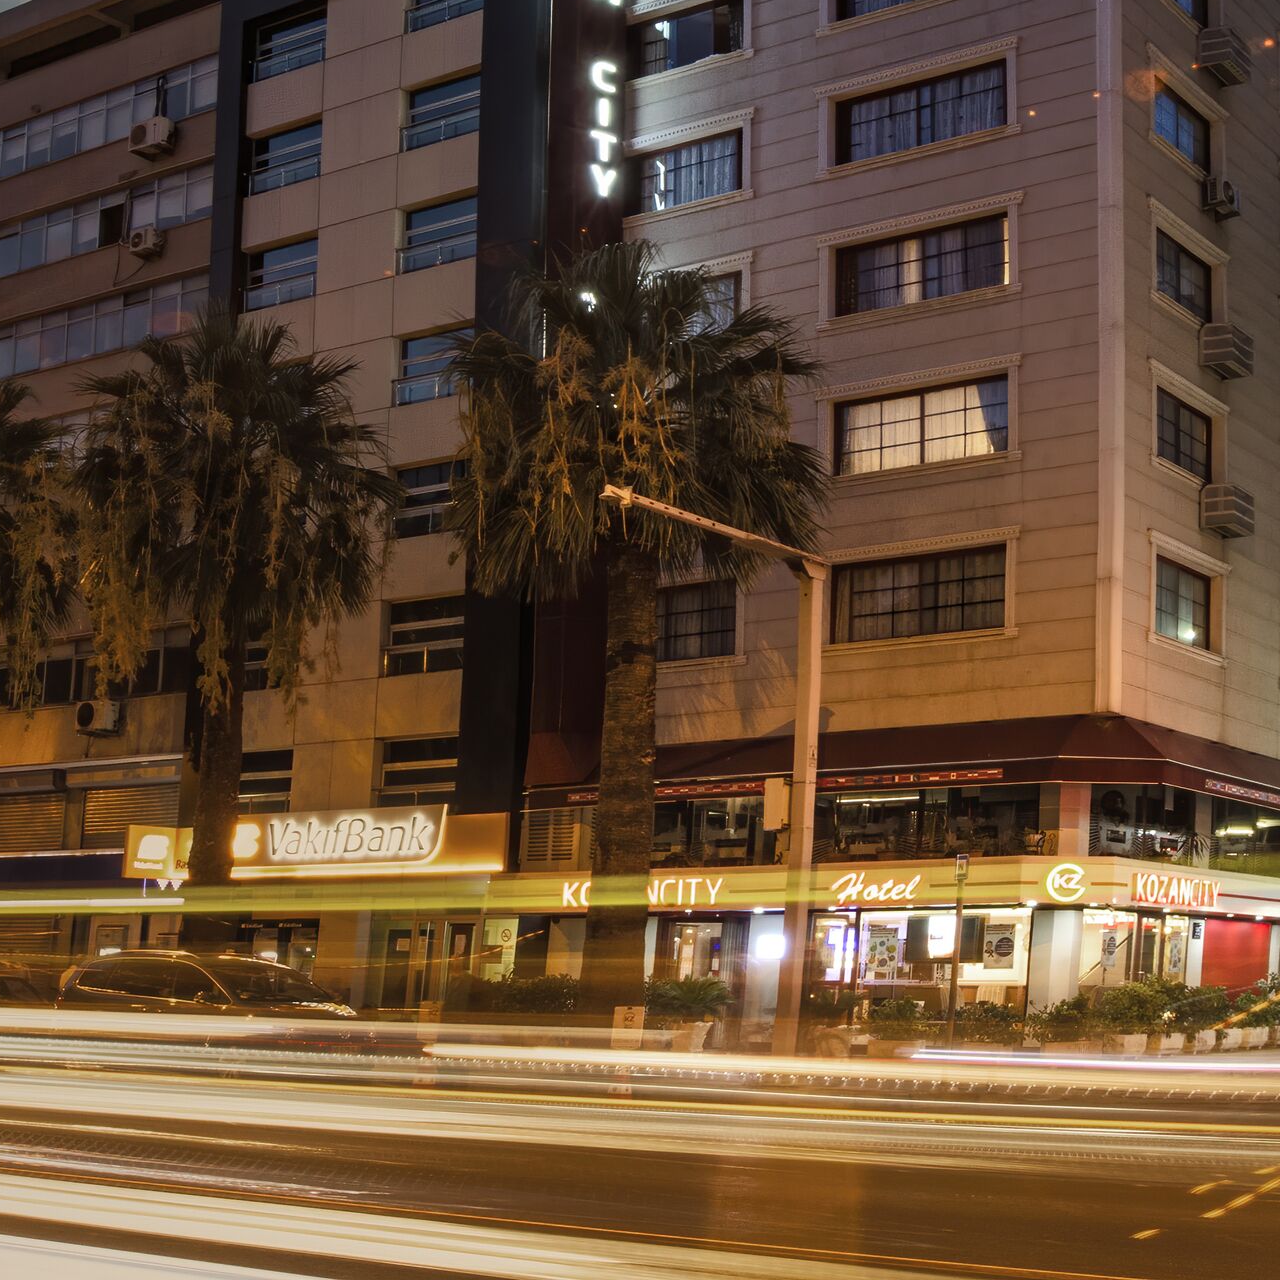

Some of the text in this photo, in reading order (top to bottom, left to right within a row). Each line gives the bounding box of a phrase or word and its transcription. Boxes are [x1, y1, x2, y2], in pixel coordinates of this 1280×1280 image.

[590, 61, 617, 197] CITY
[562, 872, 921, 908] KONCITY Hotel
